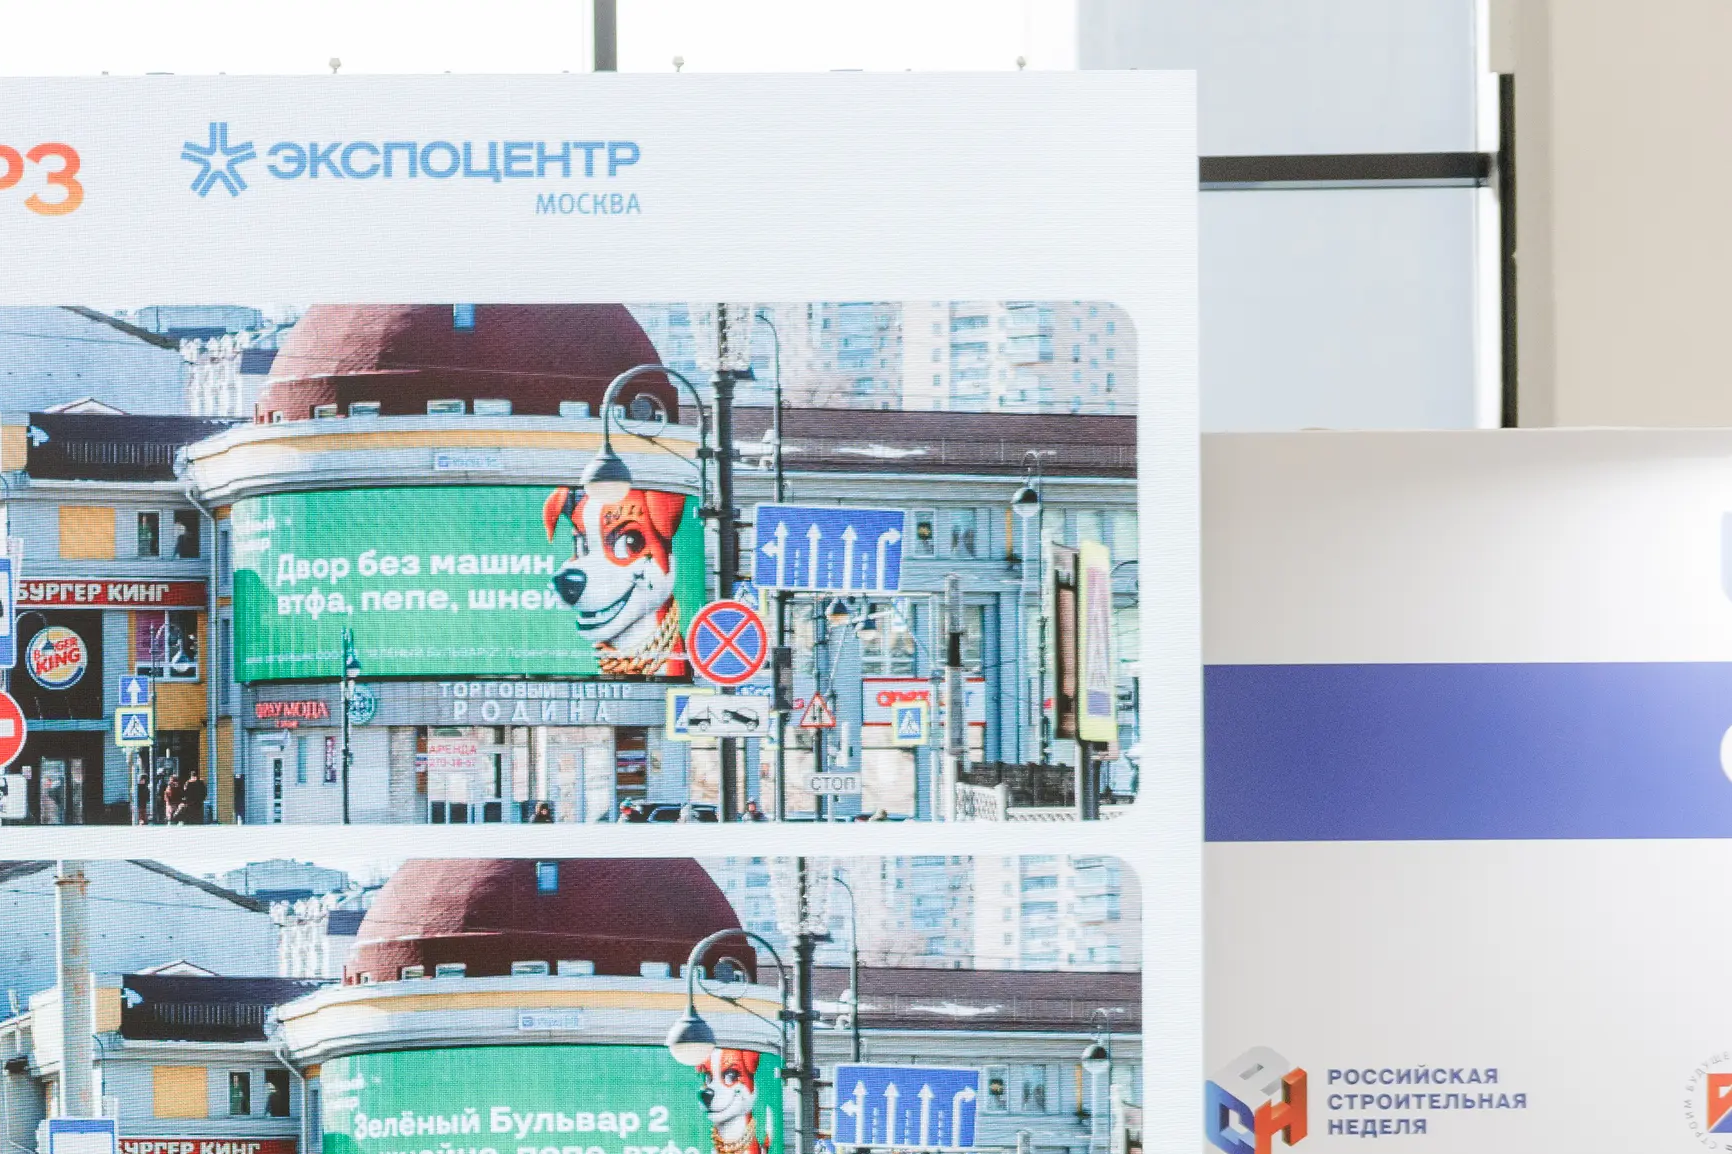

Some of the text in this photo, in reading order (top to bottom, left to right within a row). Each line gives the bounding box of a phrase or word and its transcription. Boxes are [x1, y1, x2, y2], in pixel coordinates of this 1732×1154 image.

[267, 141, 642, 185] ЭКСПОЦЕНТР
[534, 194, 642, 215] МОСКВА
[276, 550, 555, 587] Двор без машин
[17, 583, 170, 602] БУРГЕР КИНГ
[277, 587, 353, 620] втфа,
[361, 589, 459, 614] пепе,
[36, 648, 81, 677] KING
[439, 683, 632, 700] ТОРГОВЫЙ ЦЕНТР
[453, 699, 610, 723] РОДИНА
[811, 776, 856, 790] СТОП
[1327, 1065, 1499, 1085] РОССИЙСКАЯ
[1327, 1092, 1528, 1110] СТРОИТЕЛЬНАЯ
[354, 1105, 669, 1140] Зелёный Бульвар 2
[1327, 1119, 1428, 1138] НЕДЕЛЯ
